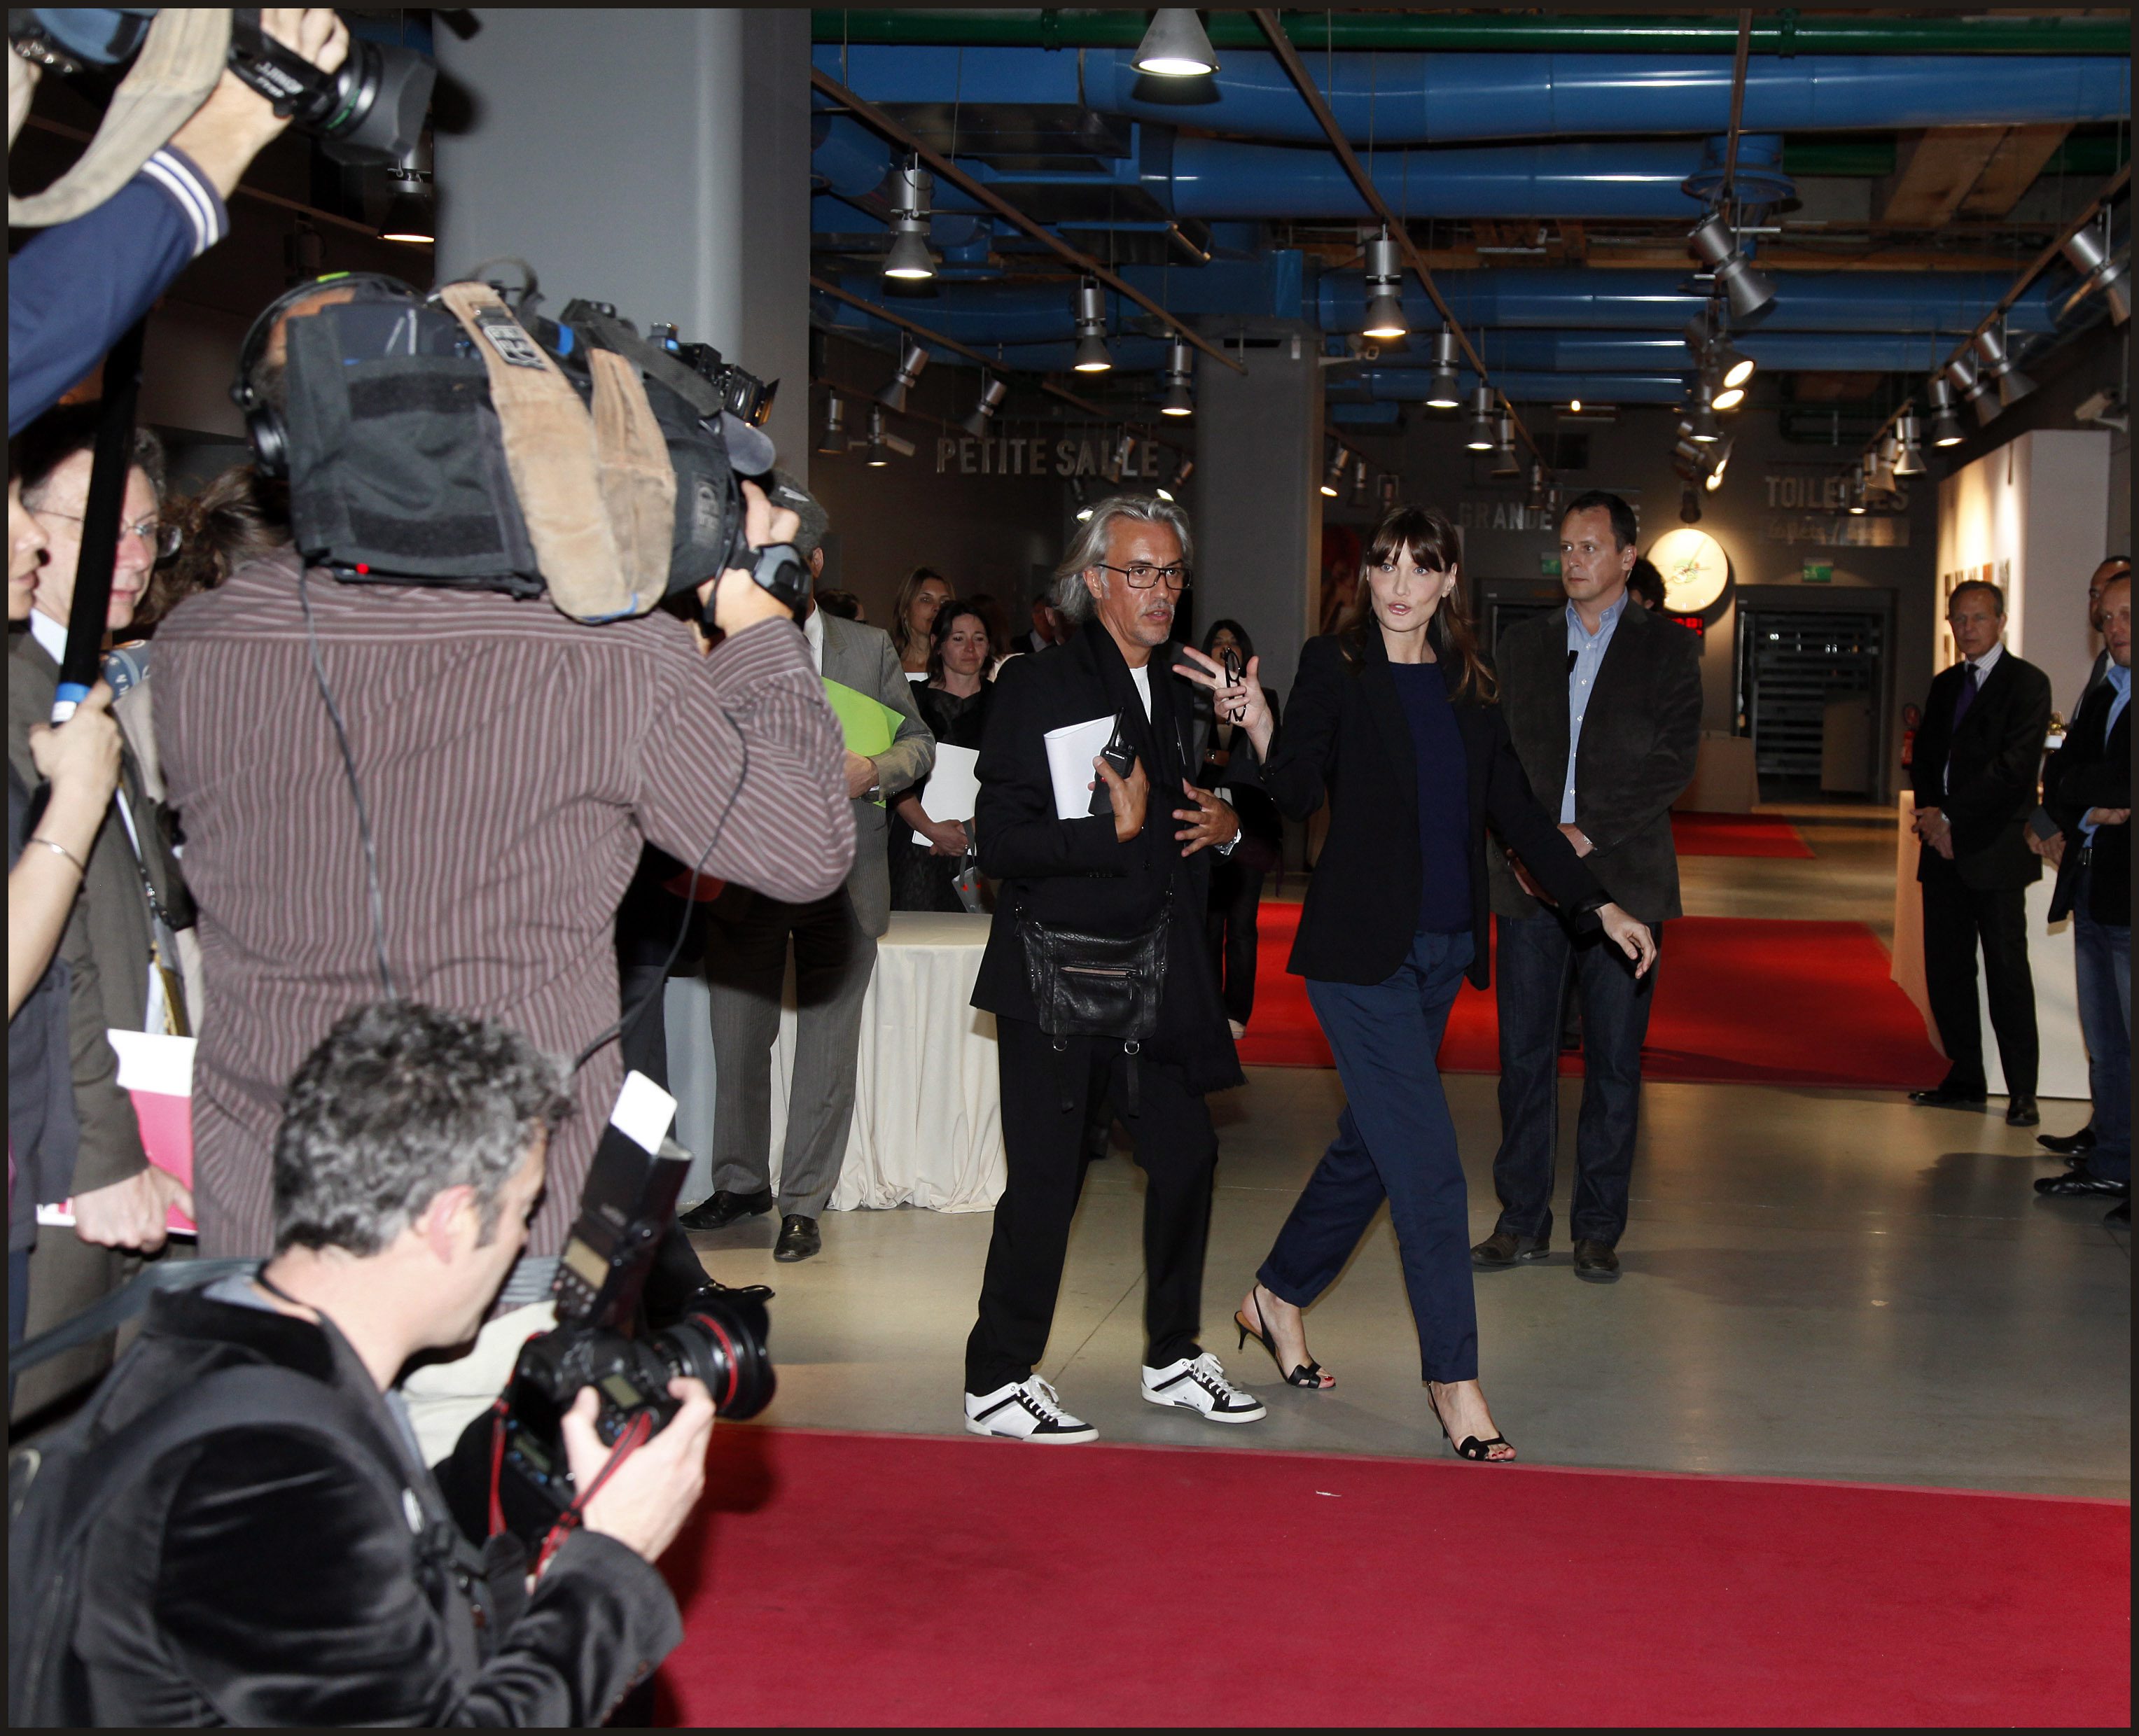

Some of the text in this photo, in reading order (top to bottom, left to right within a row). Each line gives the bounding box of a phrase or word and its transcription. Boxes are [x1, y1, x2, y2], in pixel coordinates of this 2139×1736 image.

[936, 437, 1159, 477] PETITE SALLE
[1764, 476, 1909, 510] TOILETS
